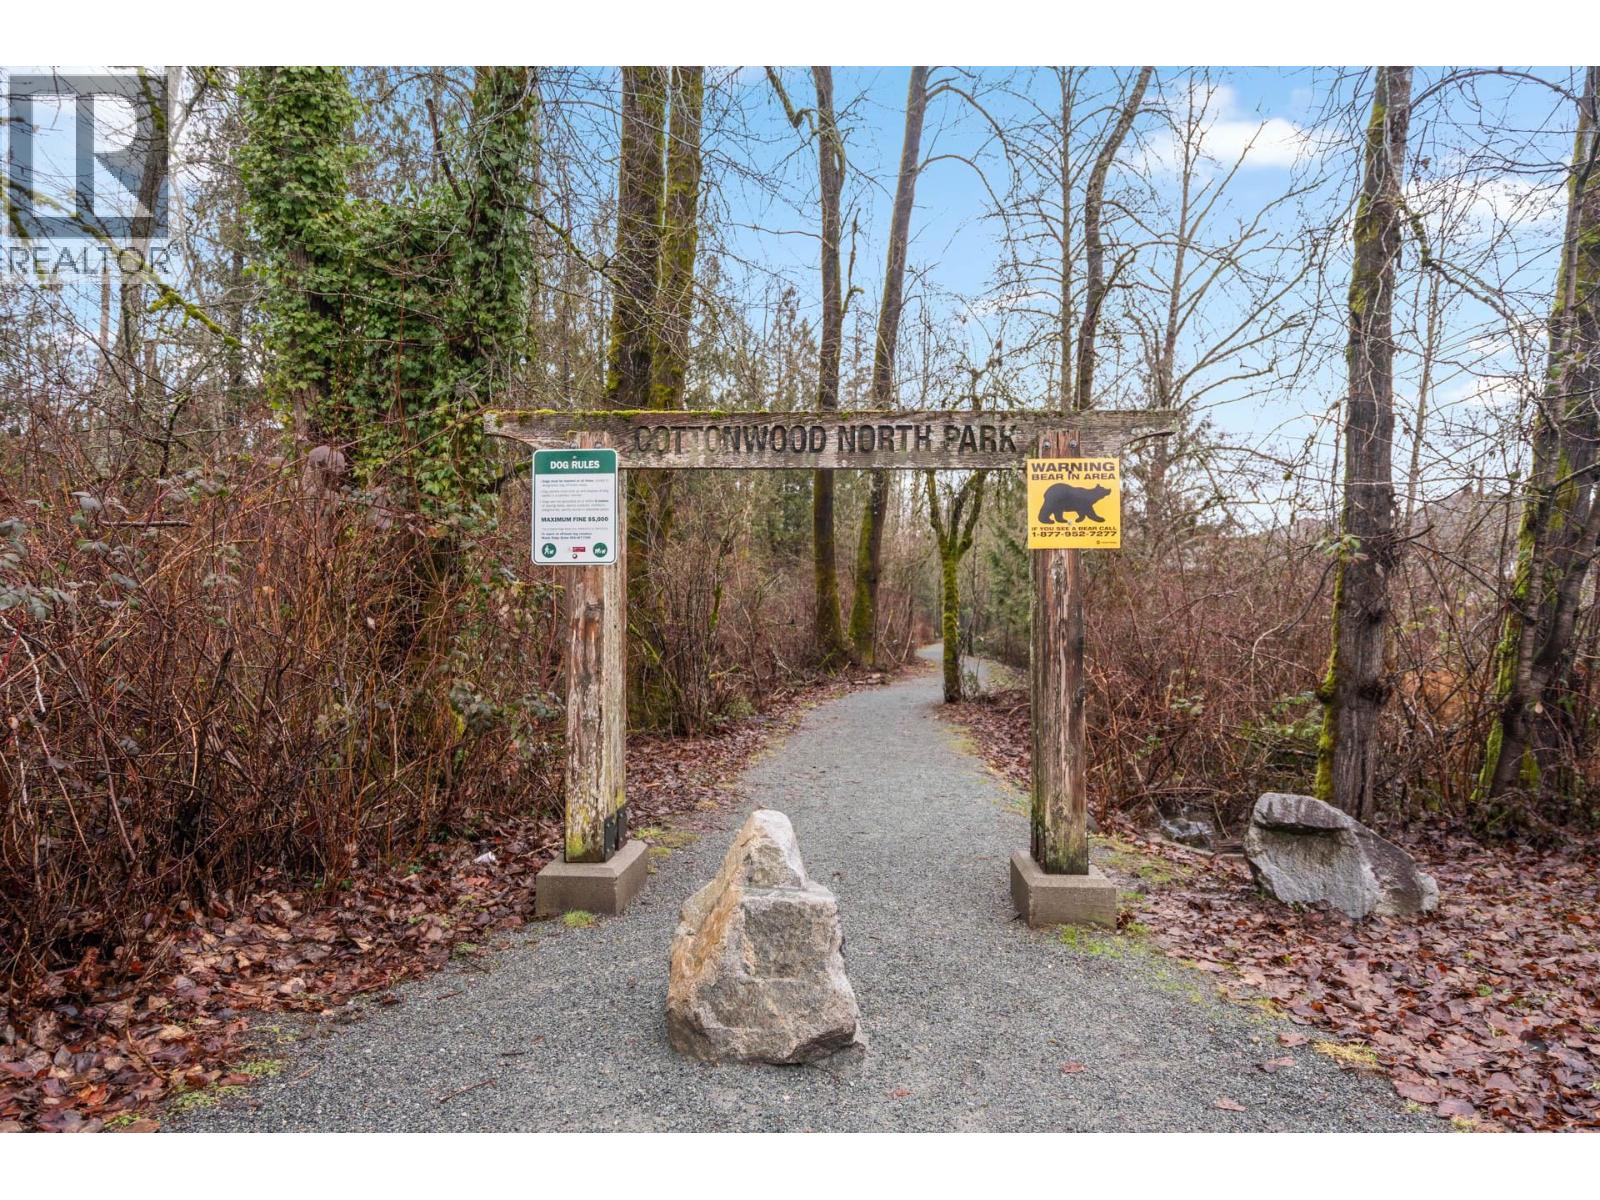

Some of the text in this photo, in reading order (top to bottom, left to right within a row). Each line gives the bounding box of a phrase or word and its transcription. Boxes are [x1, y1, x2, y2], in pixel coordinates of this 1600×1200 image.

[635, 424, 1017, 453] COTTONWOOD NORTH PARK
[550, 460, 600, 469] DOG RULES
[1031, 462, 1115, 472] WARNING
